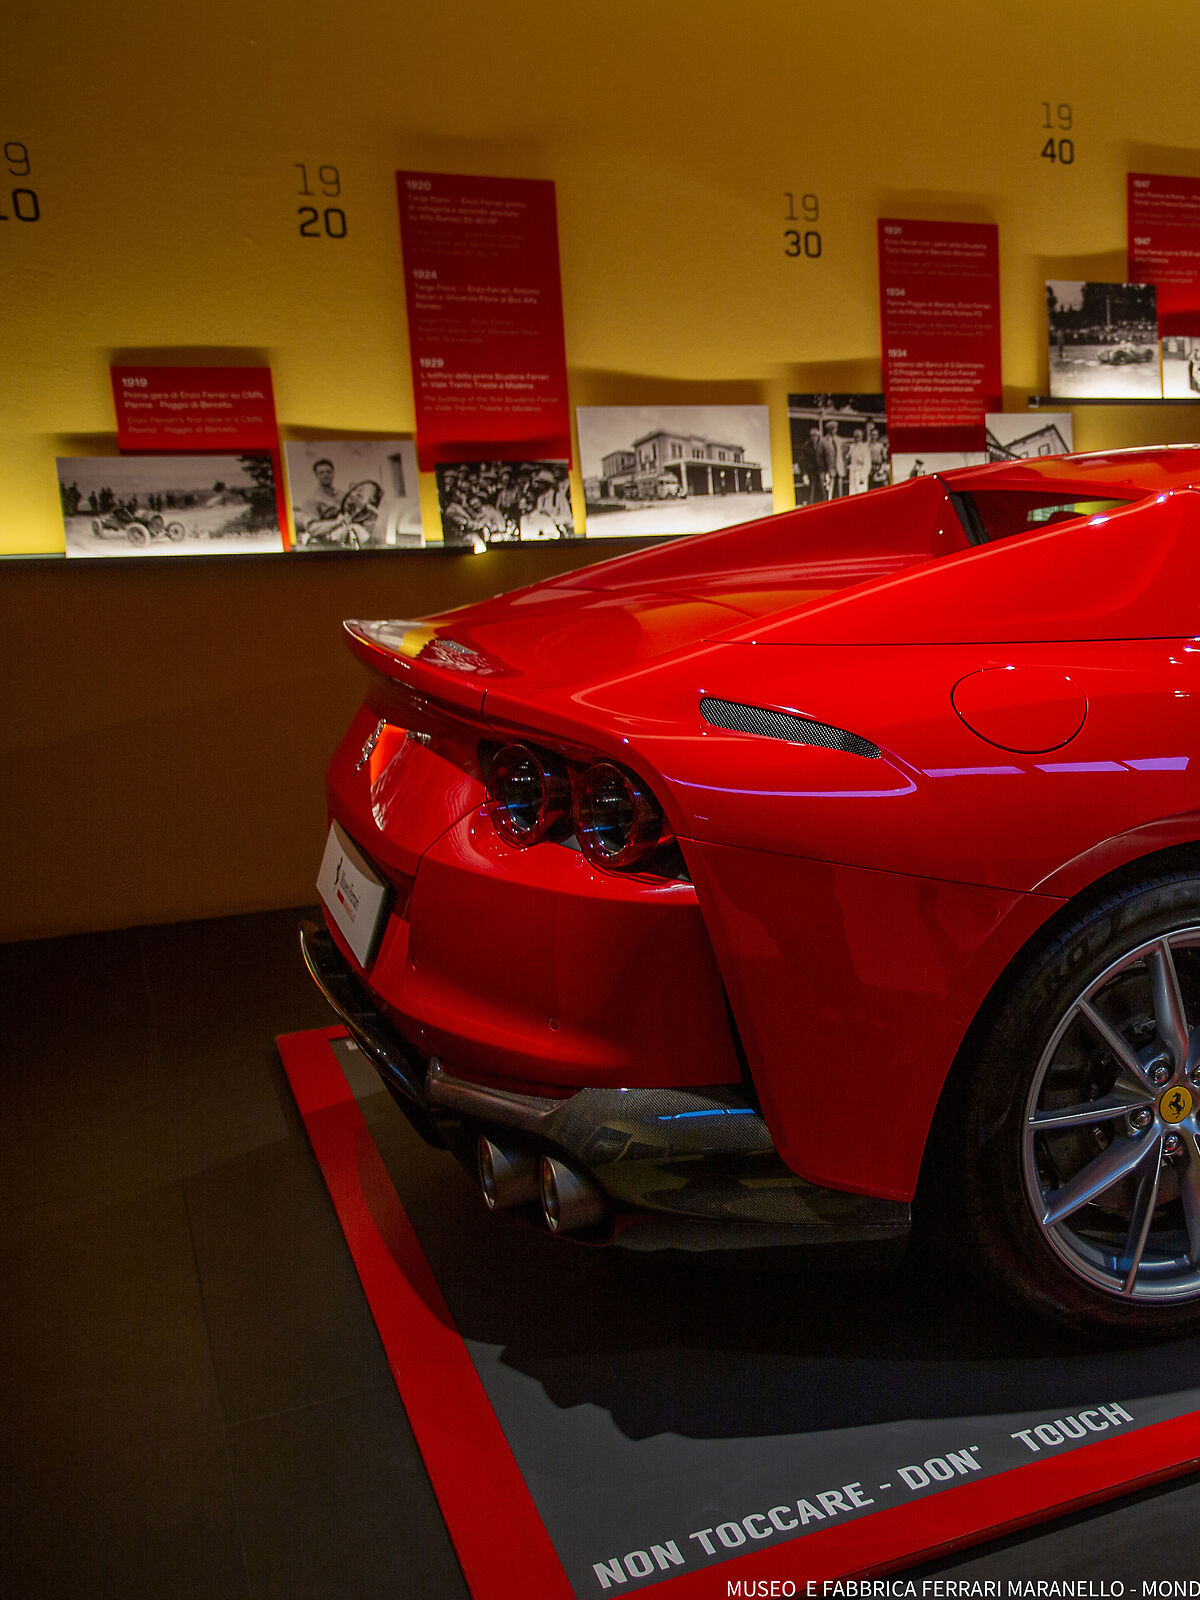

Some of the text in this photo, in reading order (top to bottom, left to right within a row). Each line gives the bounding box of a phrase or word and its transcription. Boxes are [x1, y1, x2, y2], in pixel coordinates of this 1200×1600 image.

[1042, 102, 1072, 131] 19
[1042, 137, 1074, 165] 40
[296, 164, 341, 197] 19
[298, 206, 347, 238] 20
[785, 192, 817, 223] 19
[785, 230, 822, 259] 30
[420, 357, 445, 368] 1929
[122, 377, 149, 388] 1919
[593, 1541, 686, 1589] NON
[688, 1482, 875, 1555] TOCCARE
[1010, 1402, 1135, 1452] TOUCH
